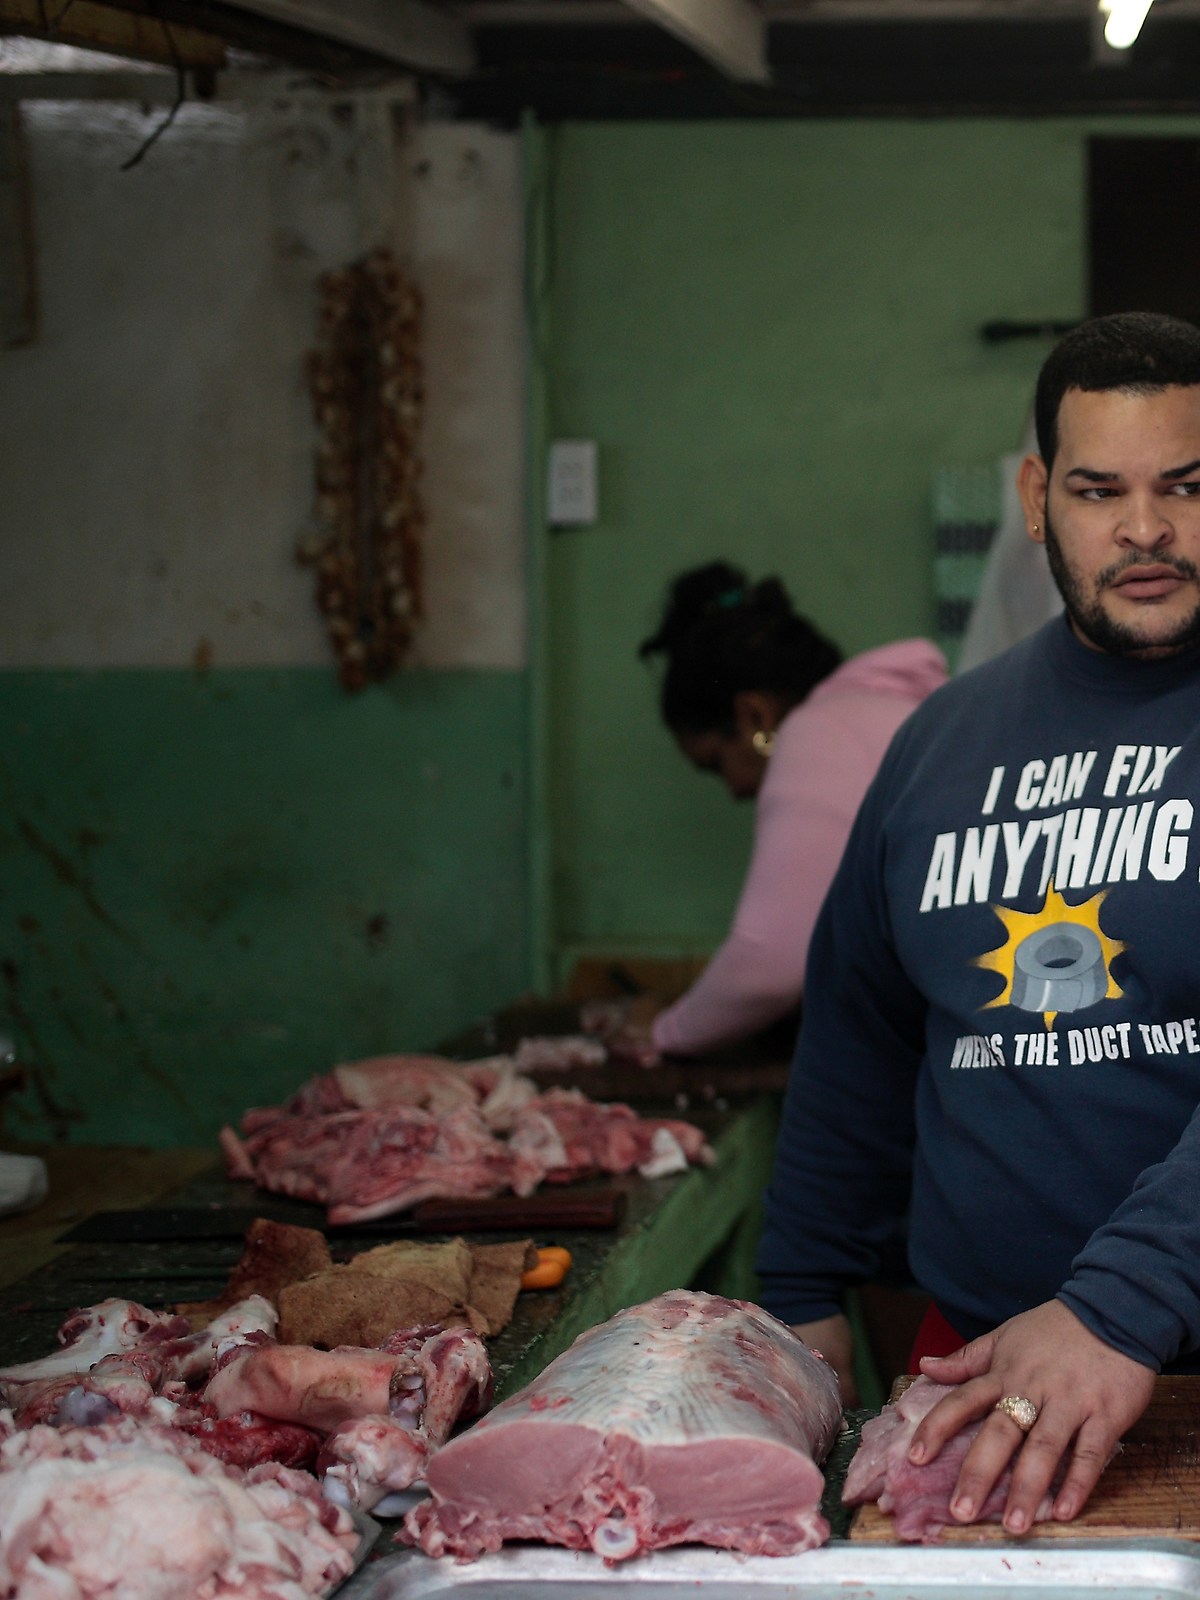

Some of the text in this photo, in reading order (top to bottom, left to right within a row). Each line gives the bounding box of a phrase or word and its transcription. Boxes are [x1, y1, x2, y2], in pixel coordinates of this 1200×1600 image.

[981, 745, 1182, 815] I CAN FIX
[1014, 1031, 1059, 1066] THE
[1067, 1022, 1131, 1065] DUCT
